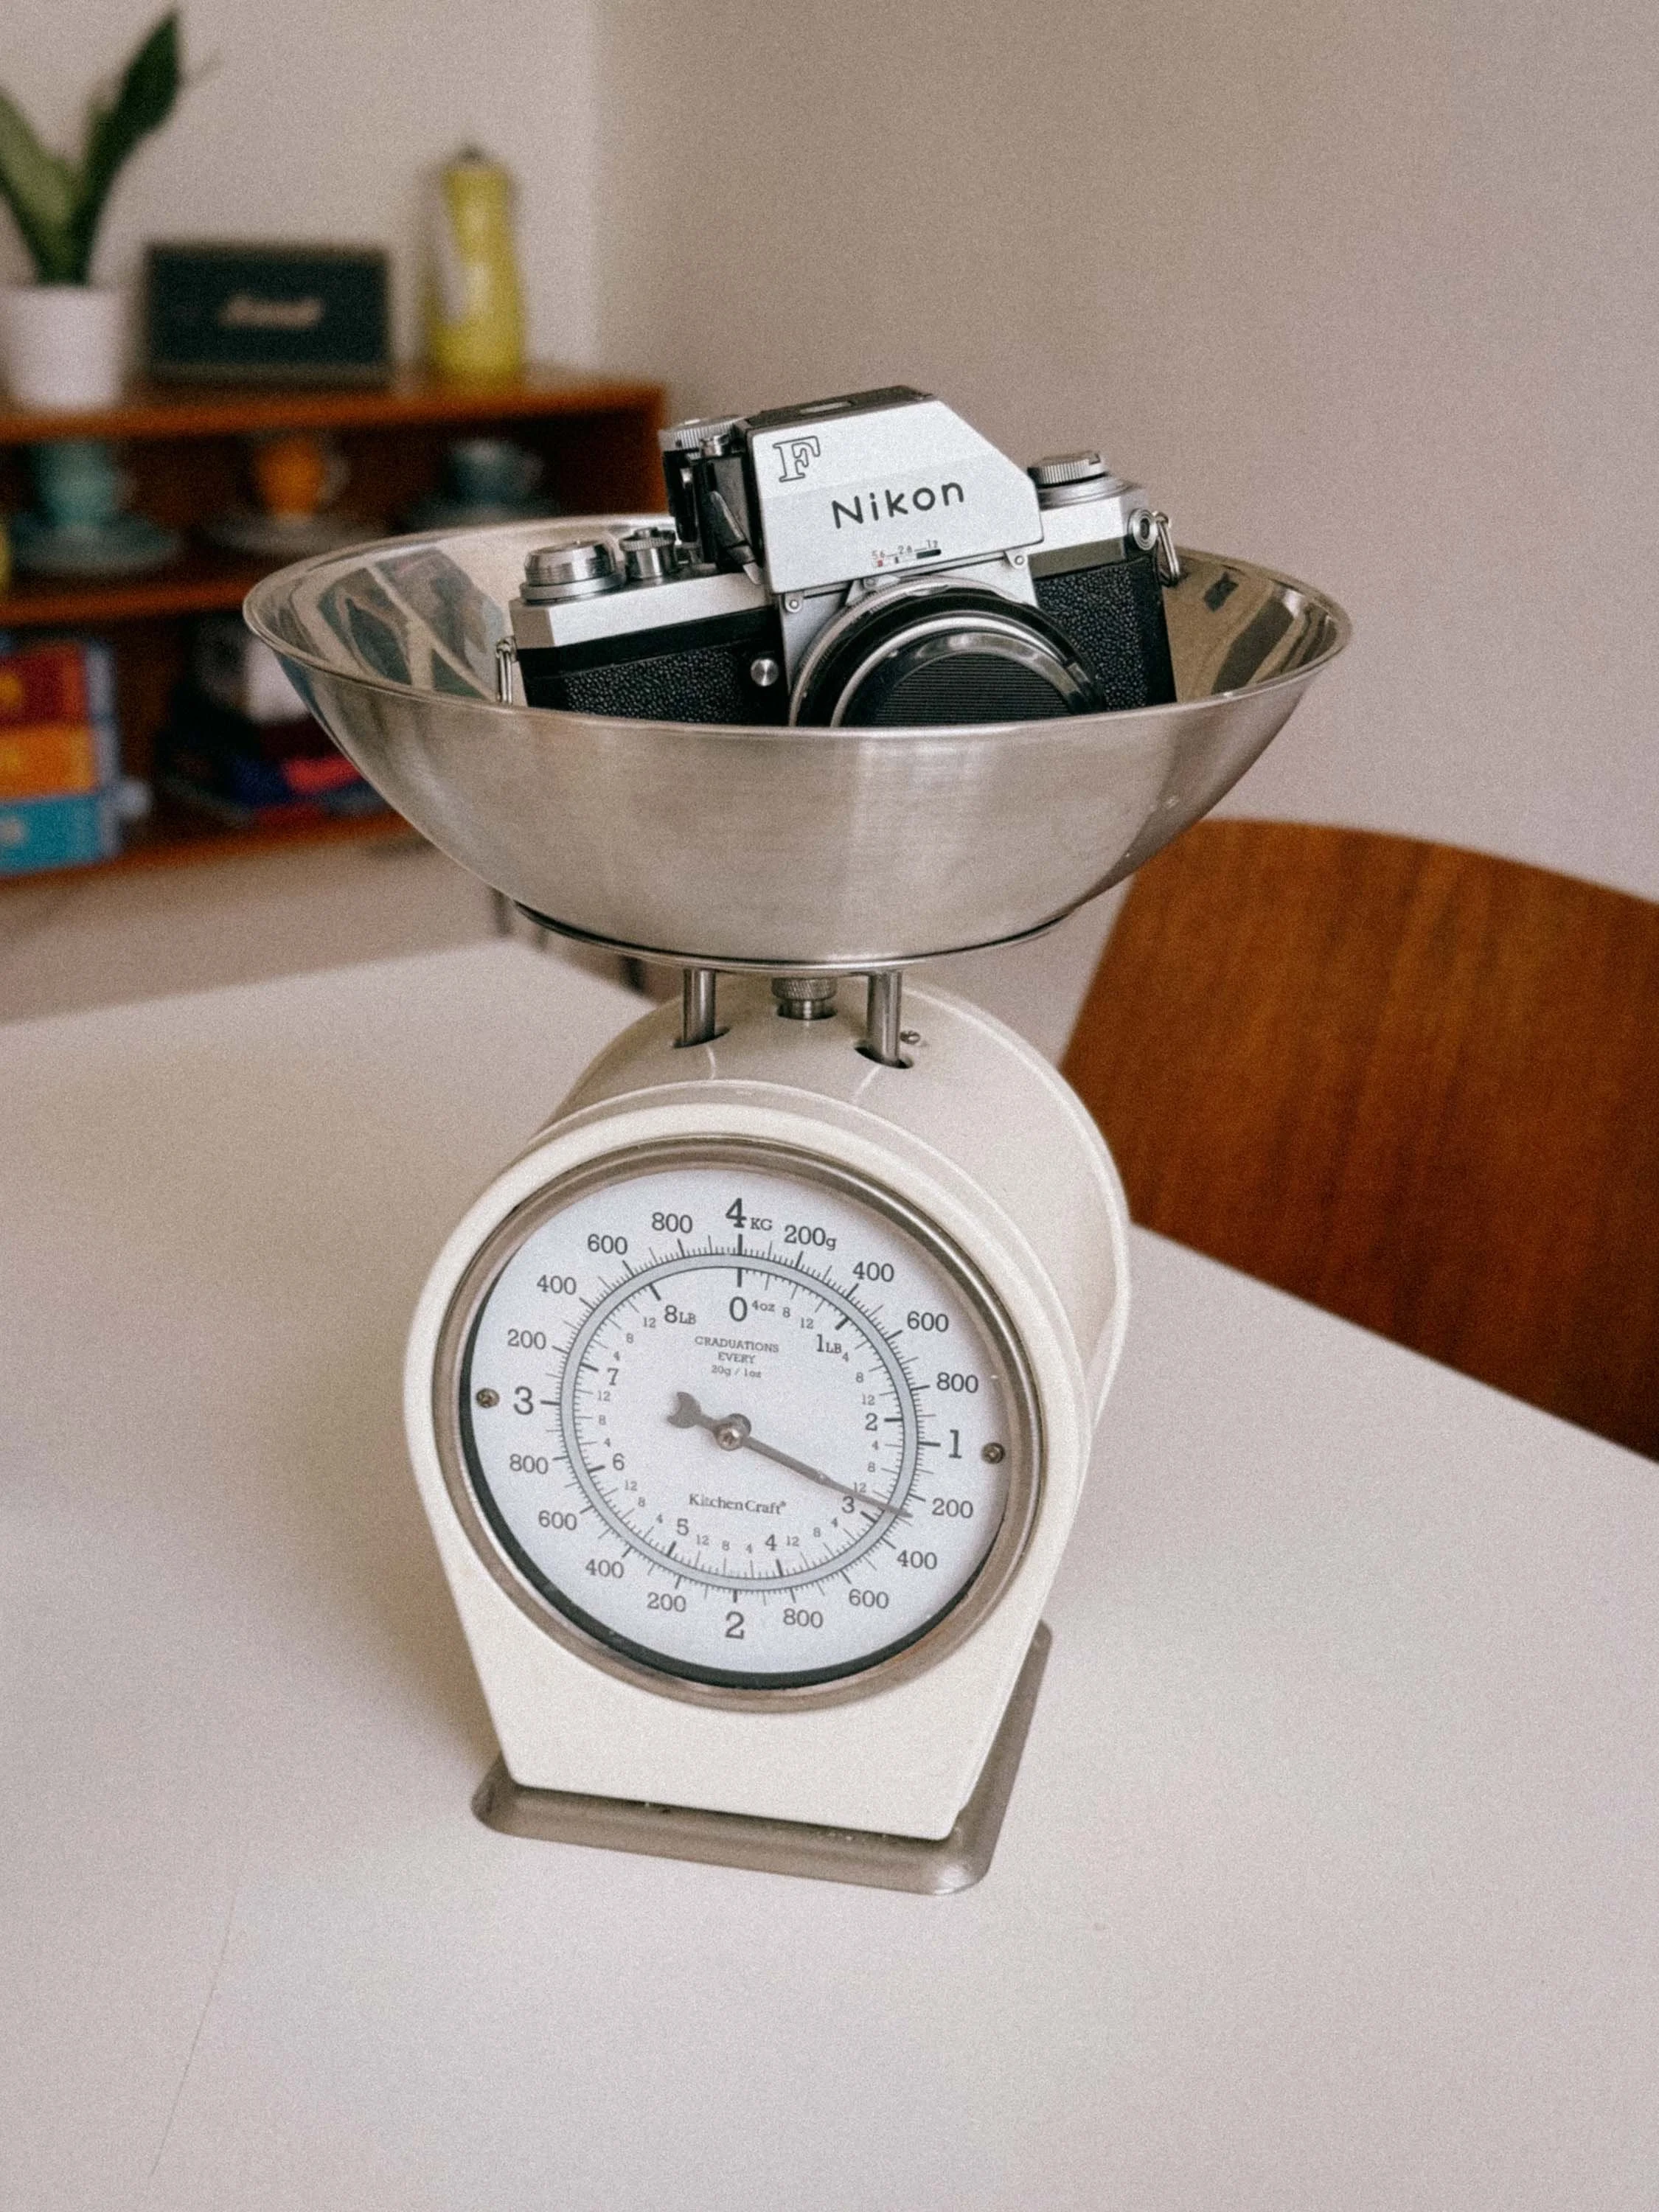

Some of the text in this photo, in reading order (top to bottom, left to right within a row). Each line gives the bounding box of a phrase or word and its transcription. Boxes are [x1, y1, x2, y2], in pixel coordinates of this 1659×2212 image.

[771, 435, 821, 484] F
[831, 482, 964, 529] Nikon
[651, 1211, 693, 1234] 800
[725, 1197, 773, 1232] 4 KG
[587, 1234, 628, 1255] 600
[784, 1224, 837, 1251] 200g
[852, 1261, 895, 1283] 400
[536, 1274, 577, 1295] 400
[642, 1316, 657, 1329] 12
[728, 1295, 749, 1323] 0
[782, 1306, 792, 1319] 8
[799, 1317, 815, 1330] 12
[907, 1311, 950, 1332] 600
[507, 1328, 547, 1350] 200
[625, 1332, 635, 1345] 8
[613, 1350, 621, 1362] 4
[717, 1352, 755, 1364] EVERY
[606, 1366, 620, 1387] 7
[855, 1371, 865, 1384] 8
[936, 1371, 979, 1394] 800
[512, 1385, 535, 1416] 3
[864, 1412, 879, 1433] 2
[603, 1437, 612, 1448] 4
[871, 1439, 880, 1451] 4
[948, 1428, 963, 1460] 1
[509, 1453, 549, 1475] 800
[611, 1452, 625, 1472] 6
[866, 1461, 877, 1473] 8
[636, 1496, 647, 1509] 8
[841, 1495, 855, 1514] 3
[931, 1498, 974, 1519] 200
[538, 1509, 577, 1531] 600
[675, 1517, 690, 1537] 5
[764, 1533, 801, 1552] 4 12
[812, 1526, 822, 1538] 8
[585, 1559, 625, 1579] 400
[897, 1550, 938, 1570] 400
[647, 1592, 686, 1613] 200
[849, 1588, 889, 1610] 600
[724, 1610, 745, 1641] 2
[782, 1608, 824, 1629] 800
